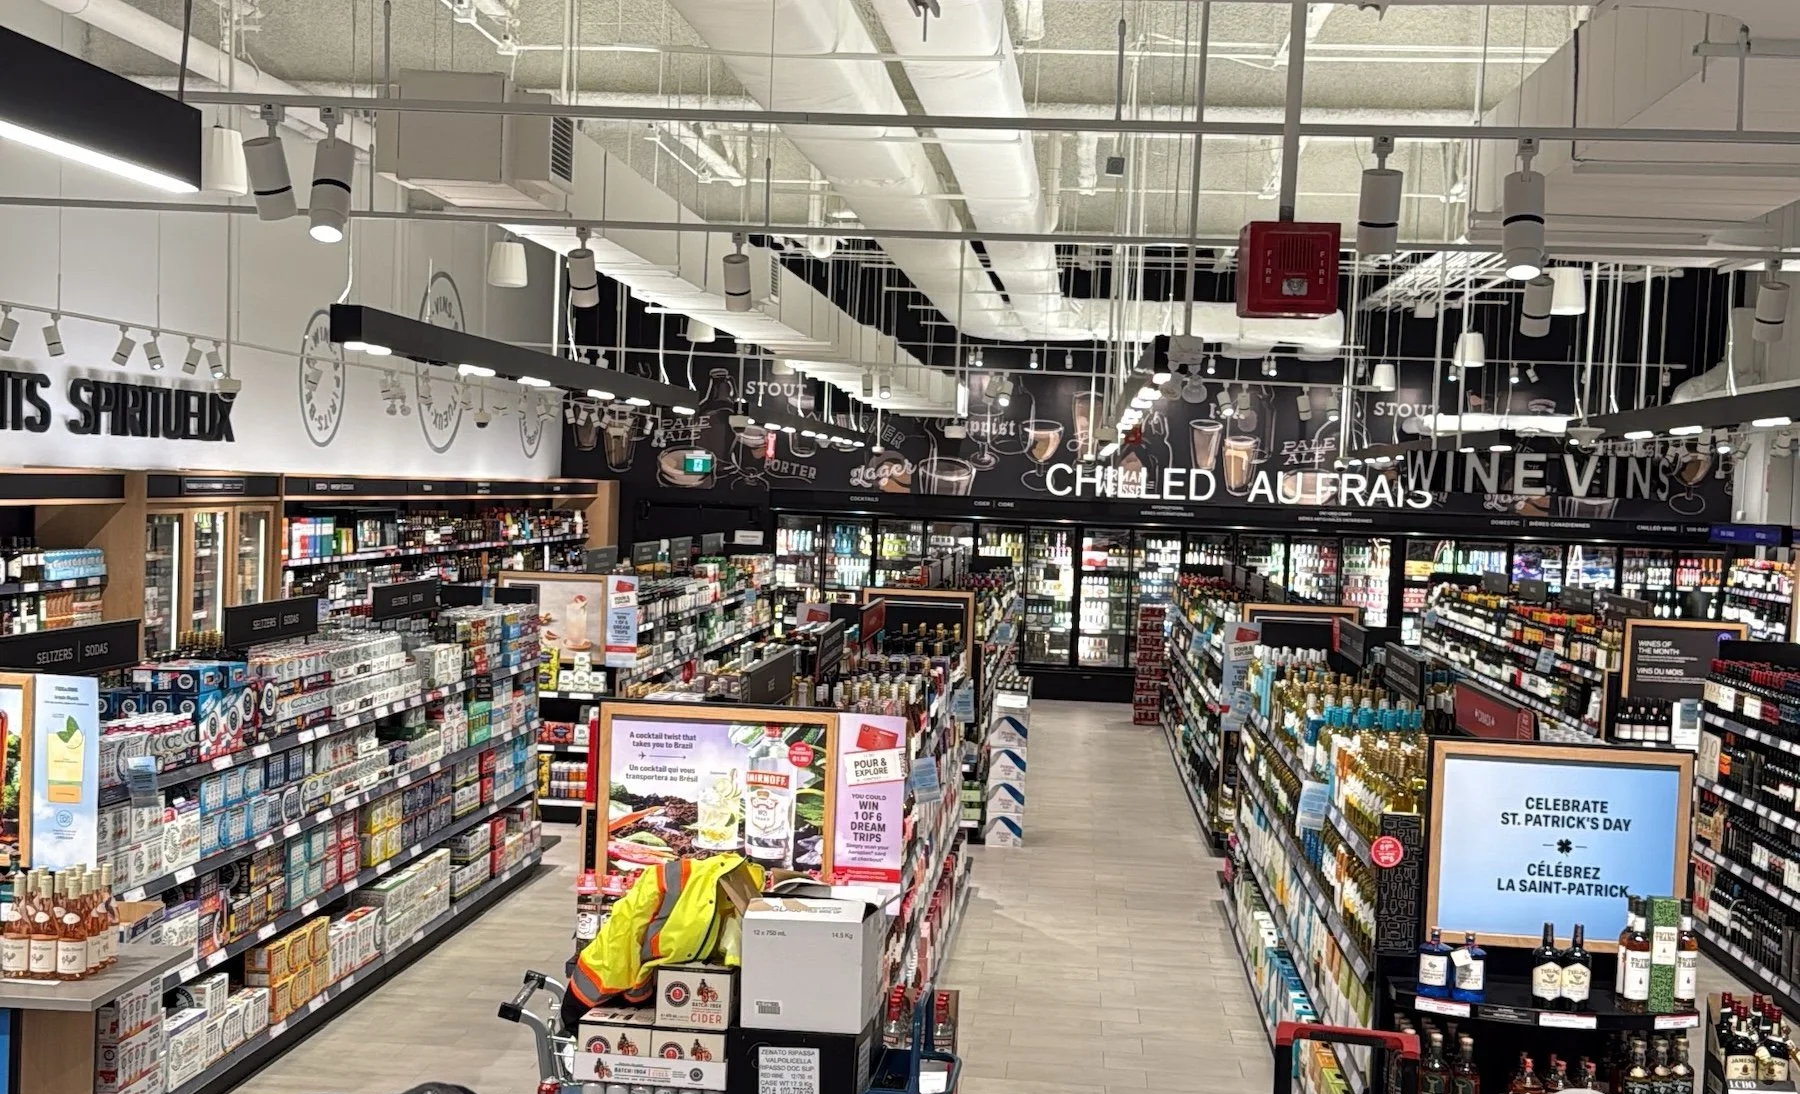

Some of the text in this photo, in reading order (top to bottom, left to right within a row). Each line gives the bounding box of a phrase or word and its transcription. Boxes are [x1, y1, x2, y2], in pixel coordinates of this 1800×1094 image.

[1265, 249, 1273, 284] FIRE
[745, 381, 808, 397] STOUT
[67, 377, 235, 442] SPIRITUEUX
[1373, 402, 1439, 418] STOUT
[1282, 437, 1336, 452] PALE
[1284, 452, 1326, 465] ALE
[765, 459, 818, 480] PORTER
[849, 458, 917, 488] Lager
[1406, 449, 1548, 496] WINE
[1563, 453, 1670, 501] VINS
[1045, 463, 1433, 509] CHILLED AU FRAIS
[36, 642, 109, 665] SELTZERS SODAS
[1638, 647, 1652, 655] THE
[1636, 667, 1654, 675] VINS
[635, 732, 663, 740] cocktail
[632, 740, 651, 748] takes
[652, 742, 665, 750] you
[639, 765, 667, 773] cocktail
[667, 766, 679, 774] qui
[854, 757, 887, 769] POUR &
[625, 773, 668, 781] transportera
[854, 767, 889, 777] EXPLORE
[858, 800, 879, 811] WIN
[1525, 796, 1609, 814] CELEBRATE
[854, 811, 883, 822] 1 OF 6
[1500, 812, 1632, 832] ST. PATRICK'S DAY
[850, 821, 886, 832] DREAM
[852, 832, 882, 843] TRIPS
[1527, 860, 1601, 880] CÉLÉBREZ
[1497, 877, 1630, 899] LA SAINT-PATRICK
[690, 1012, 722, 1024] CIDER
[1728, 1080, 1757, 1089] LCBO
